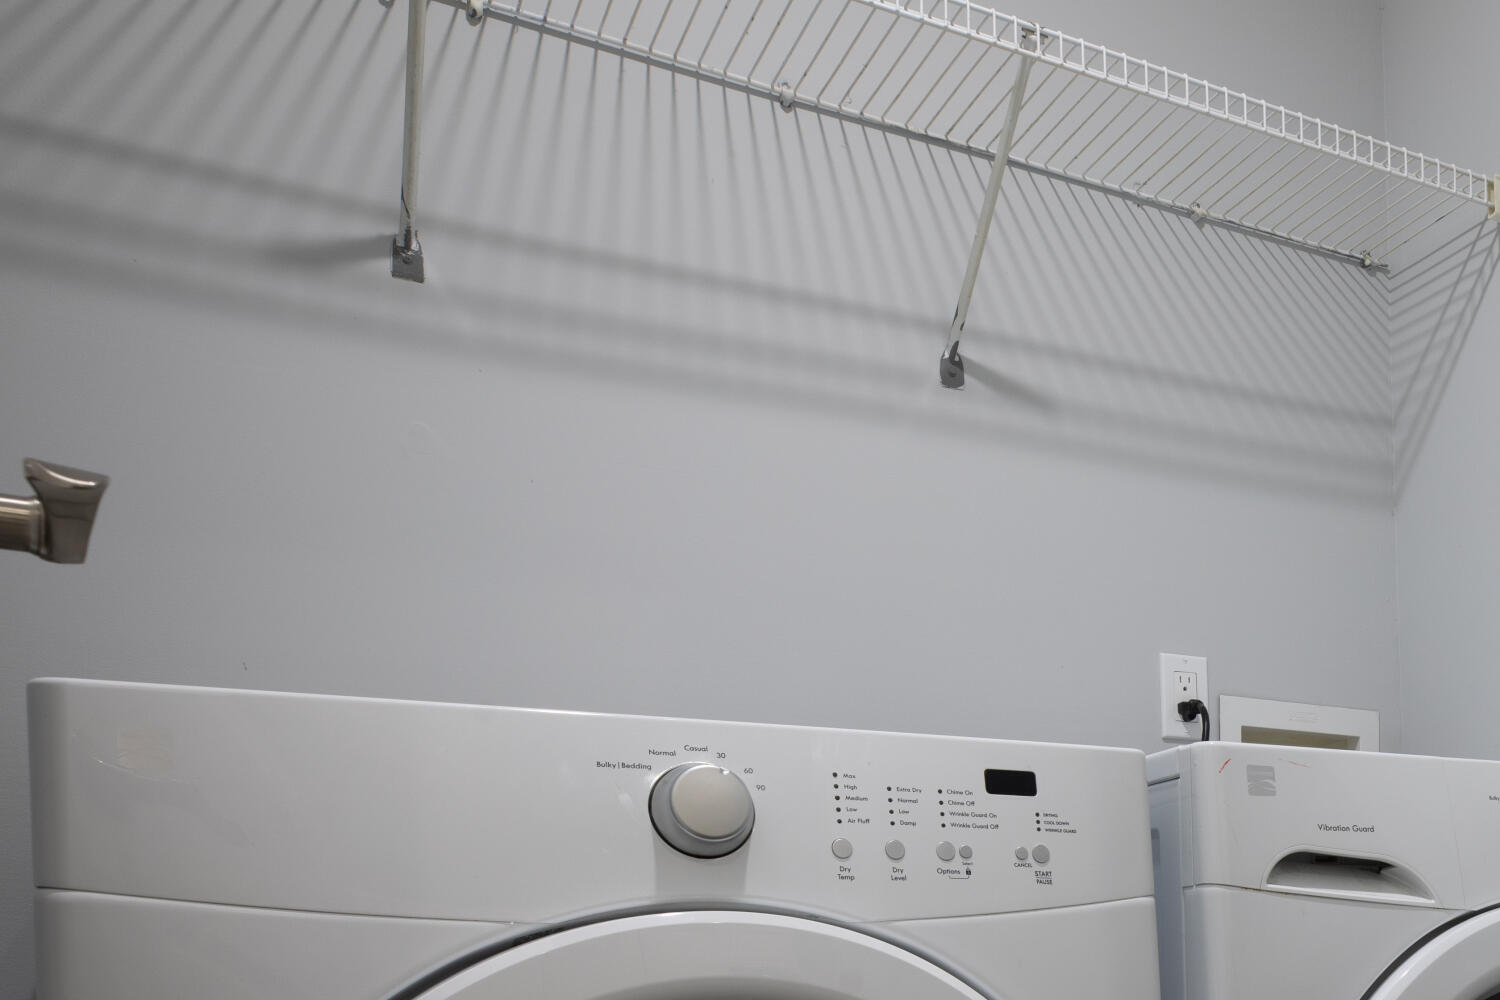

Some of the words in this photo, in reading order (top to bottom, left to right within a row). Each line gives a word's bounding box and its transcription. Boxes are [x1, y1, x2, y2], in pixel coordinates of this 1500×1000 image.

[684, 744, 709, 752] Casual
[648, 749, 676, 757] Normal
[621, 762, 652, 770] Bedding
[1317, 823, 1350, 832] Vibration
[1352, 824, 1375, 833] Guard
